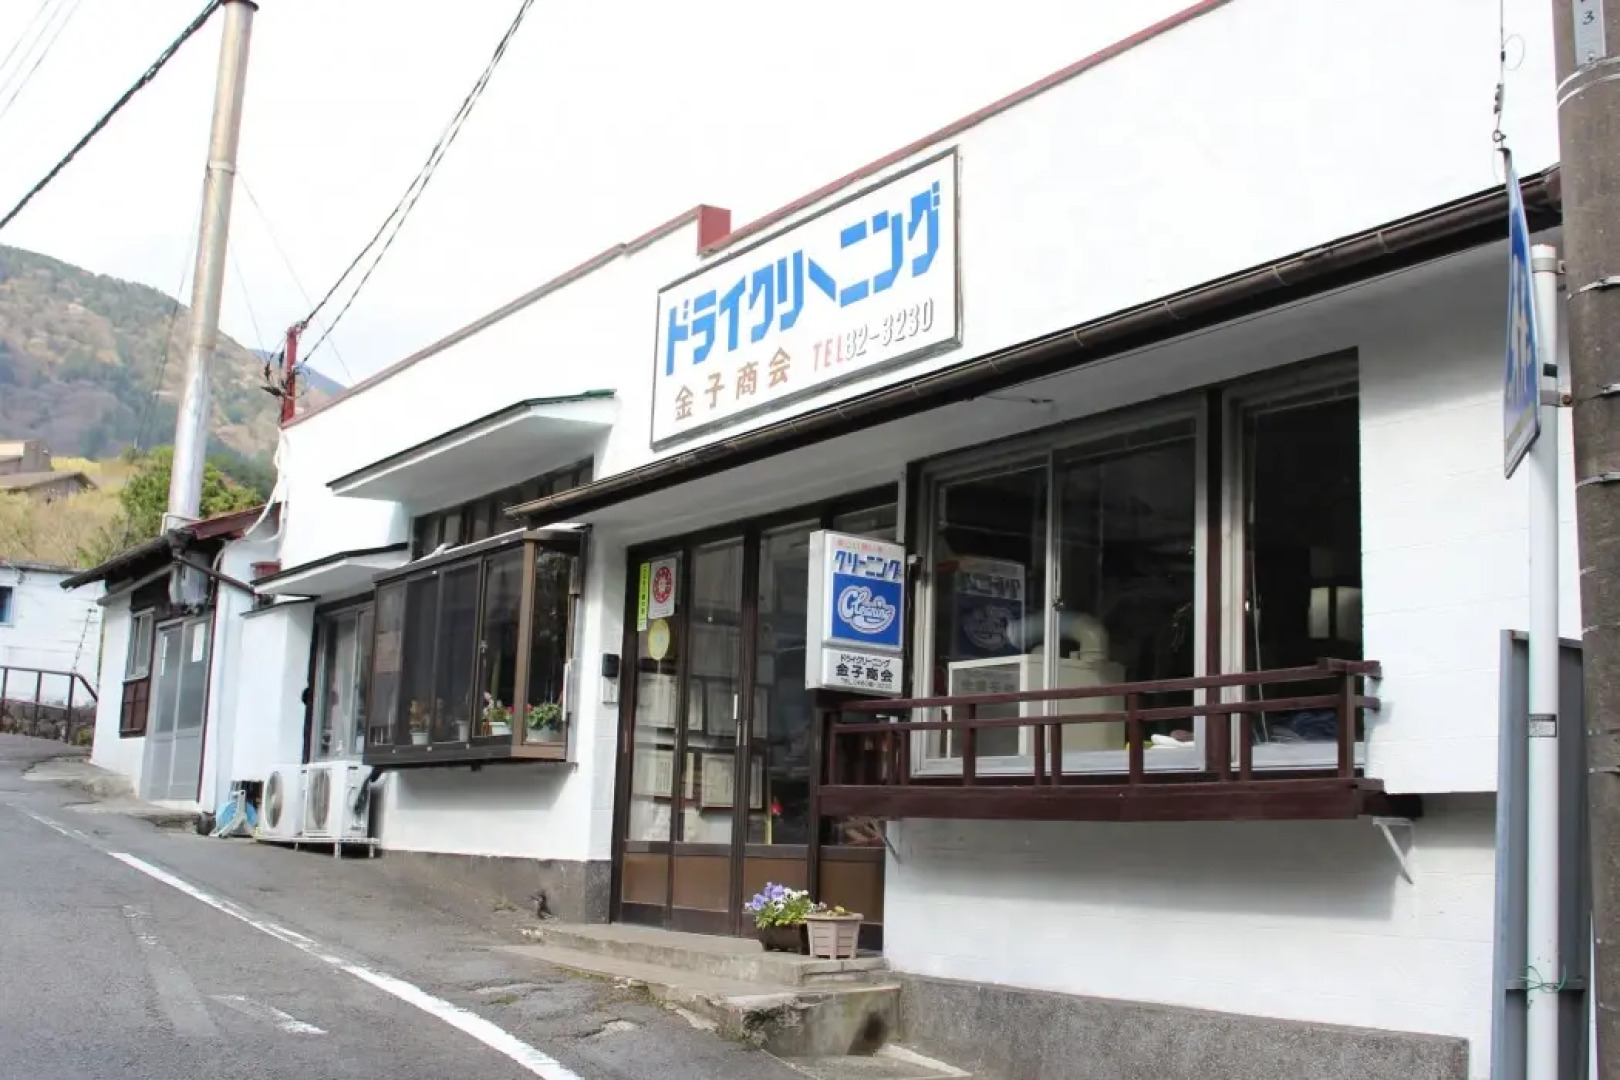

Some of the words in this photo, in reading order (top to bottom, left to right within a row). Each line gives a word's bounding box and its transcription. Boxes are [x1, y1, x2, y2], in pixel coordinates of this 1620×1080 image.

[666, 180, 941, 376] ドライクリーニング
[674, 346, 791, 421] 金子商会
[834, 550, 902, 580] クリーニング
[835, 663, 894, 682] 金子商会
[840, 653, 891, 668] ドライクリーニング
